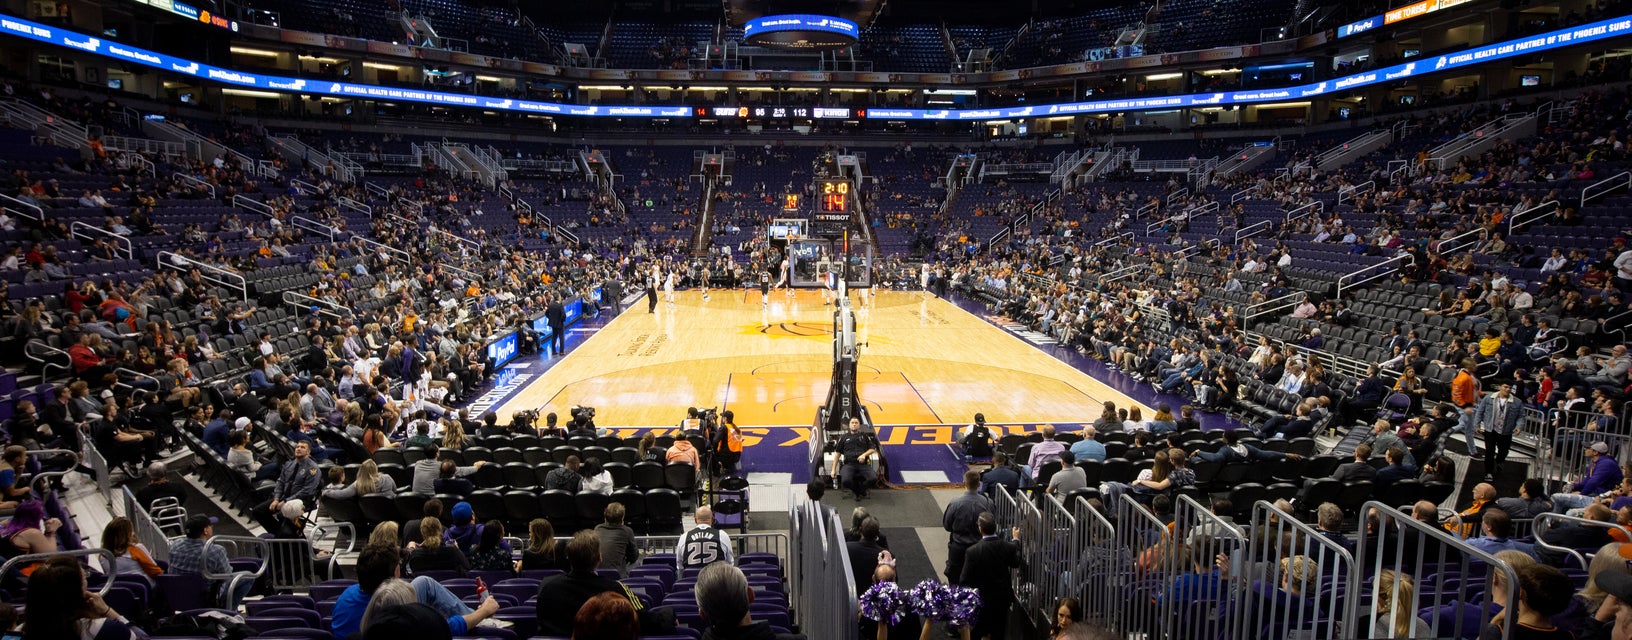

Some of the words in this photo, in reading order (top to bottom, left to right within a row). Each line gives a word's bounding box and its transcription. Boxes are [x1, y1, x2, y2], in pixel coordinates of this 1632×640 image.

[1385, 10, 1402, 22] TIME
[1403, 8, 1410, 18] TO
[1410, 4, 1427, 15] RISE
[1353, 20, 1374, 32] PayPal
[1449, 53, 1473, 65] OFFICIAL
[1474, 48, 1497, 60] HEALTH
[1498, 44, 1515, 55] CARE
[1515, 38, 1546, 51] PARTNER
[1547, 35, 1557, 45] OF
[1558, 32, 1572, 43] THE
[1573, 25, 1607, 40] PHOENIX
[1608, 20, 1631, 32] SUNS
[344, 85, 367, 94] OFFICIAL
[368, 88, 388, 97] HEALTH
[389, 89, 403, 98] CARE
[403, 90, 426, 99] PARTNER
[433, 93, 442, 101] THE
[443, 95, 464, 103] PHOENIX
[697, 108, 706, 116] 14
[755, 108, 765, 116] 95
[793, 109, 807, 117] 112
[1078, 103, 1095, 111] HEALTH
[1108, 101, 1128, 109] PARTNER
[825, 182, 848, 194] 2:10
[828, 195, 845, 211] 14
[497, 340, 515, 359] PayPal
[841, 384, 851, 420] NBA
[687, 541, 718, 565] 25
